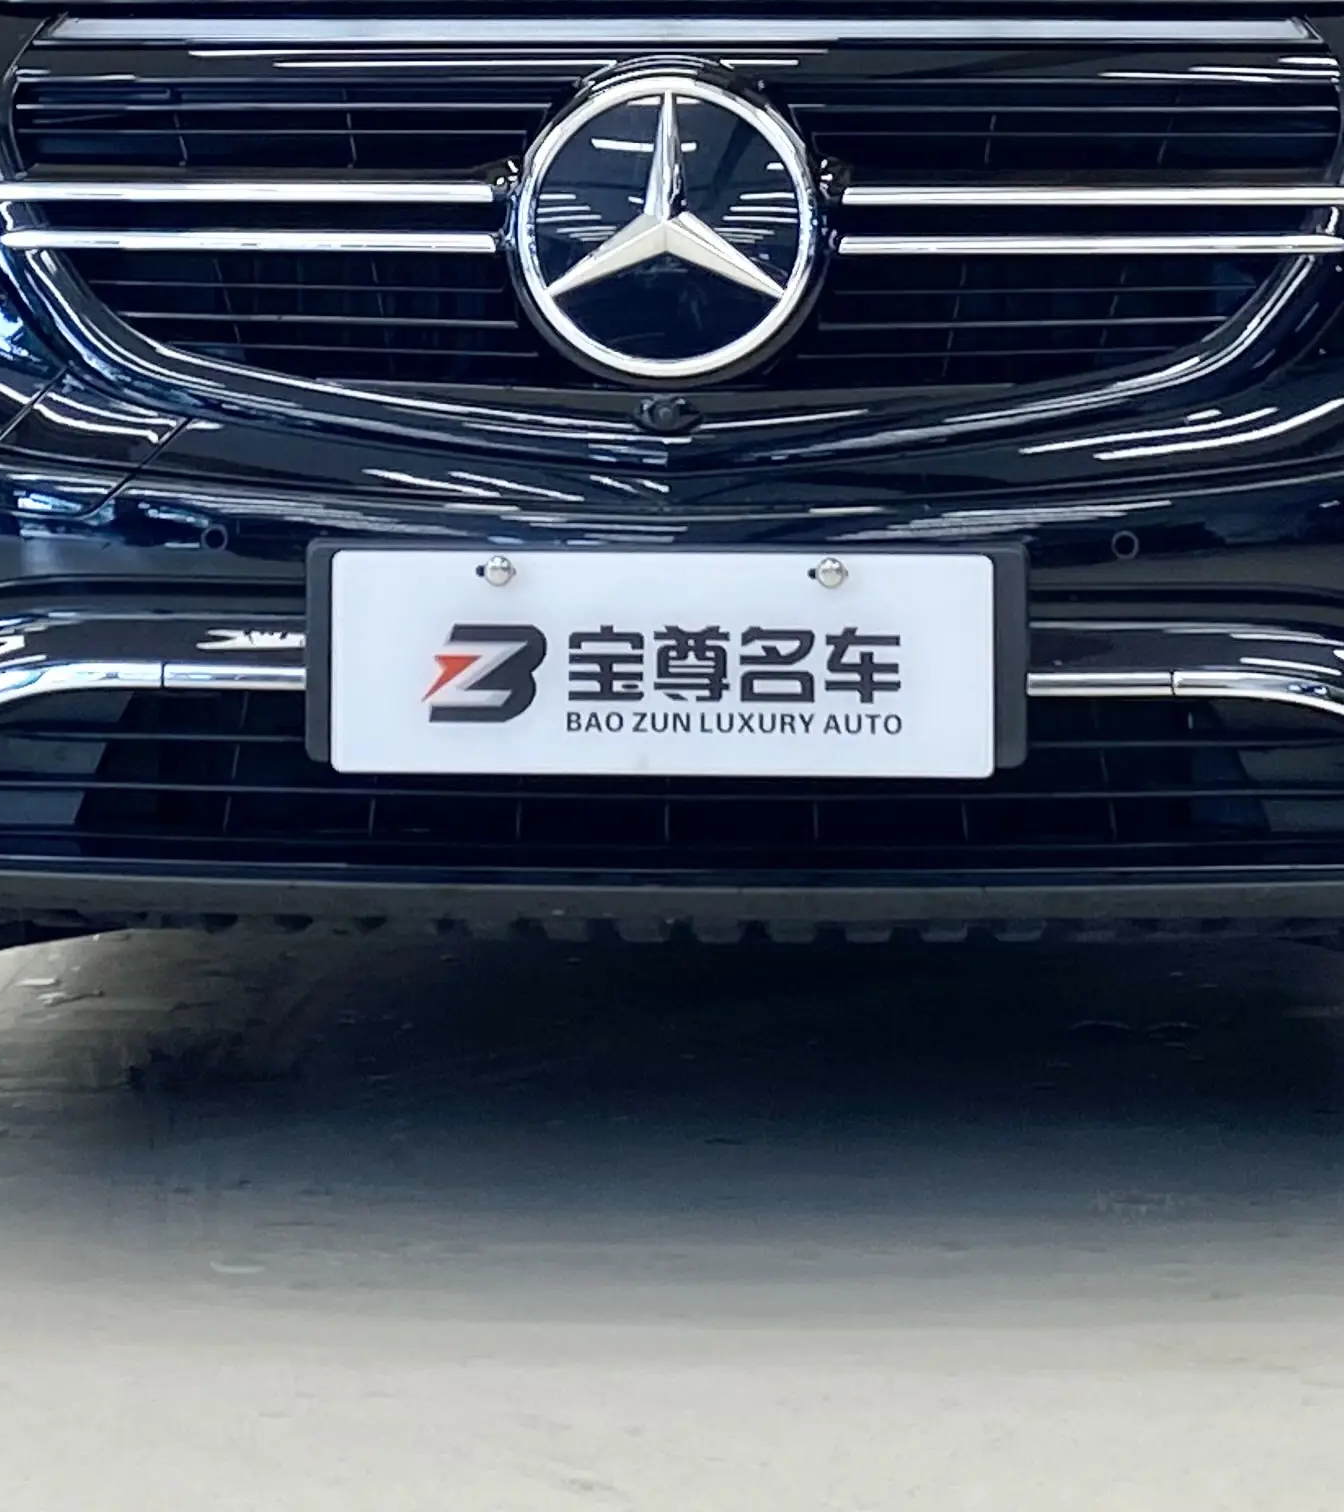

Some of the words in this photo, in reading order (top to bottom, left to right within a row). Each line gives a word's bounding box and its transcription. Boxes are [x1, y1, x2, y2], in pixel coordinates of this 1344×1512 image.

[568, 624, 902, 704] 宝尊名车
[566, 711, 625, 733] BAO
[632, 711, 692, 733] ZUN
[699, 711, 815, 734] LUXURY
[823, 713, 903, 735] AUTO
